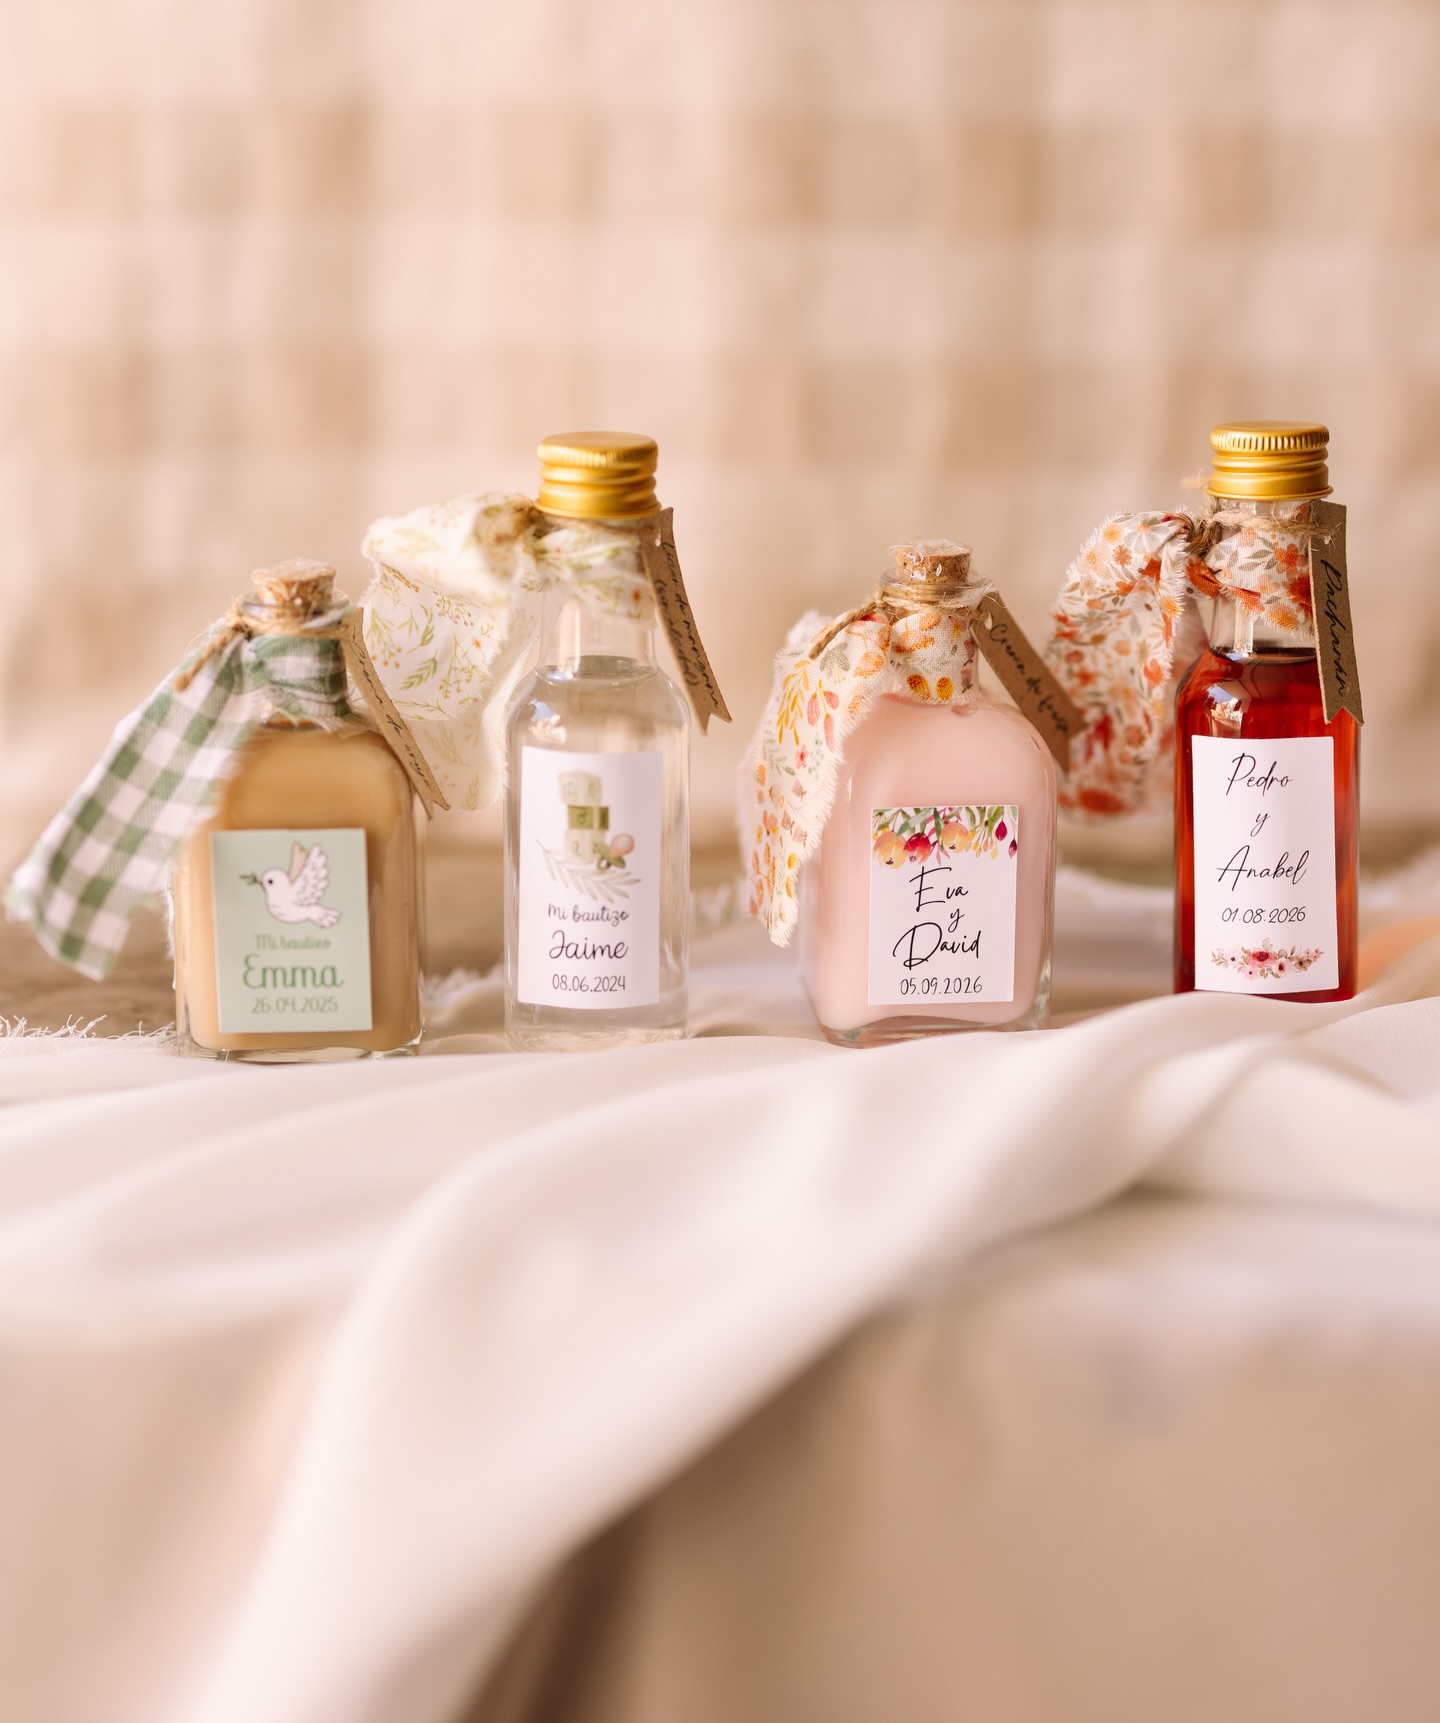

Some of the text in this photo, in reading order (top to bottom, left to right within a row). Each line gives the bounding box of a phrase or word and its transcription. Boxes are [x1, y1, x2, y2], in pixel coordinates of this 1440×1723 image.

[675, 593, 689, 615] de
[990, 624, 1025, 675] Crema
[1026, 676, 1042, 698] de
[386, 714, 403, 738] de
[1226, 752, 1293, 797] Pedro
[1250, 812, 1270, 837] y
[1216, 845, 1309, 891] Anabel
[909, 866, 969, 912] Eva
[547, 903, 630, 927] Mi bautizo
[948, 908, 965, 933] y
[1221, 906, 1306, 923] 01.08.2026
[549, 930, 629, 959] Jaime
[892, 922, 982, 970] David
[243, 953, 344, 989] Emma
[552, 974, 626, 992] 08.06.2024
[900, 976, 983, 995] 05.09.2026
[252, 996, 339, 1014] 26.04.2025
